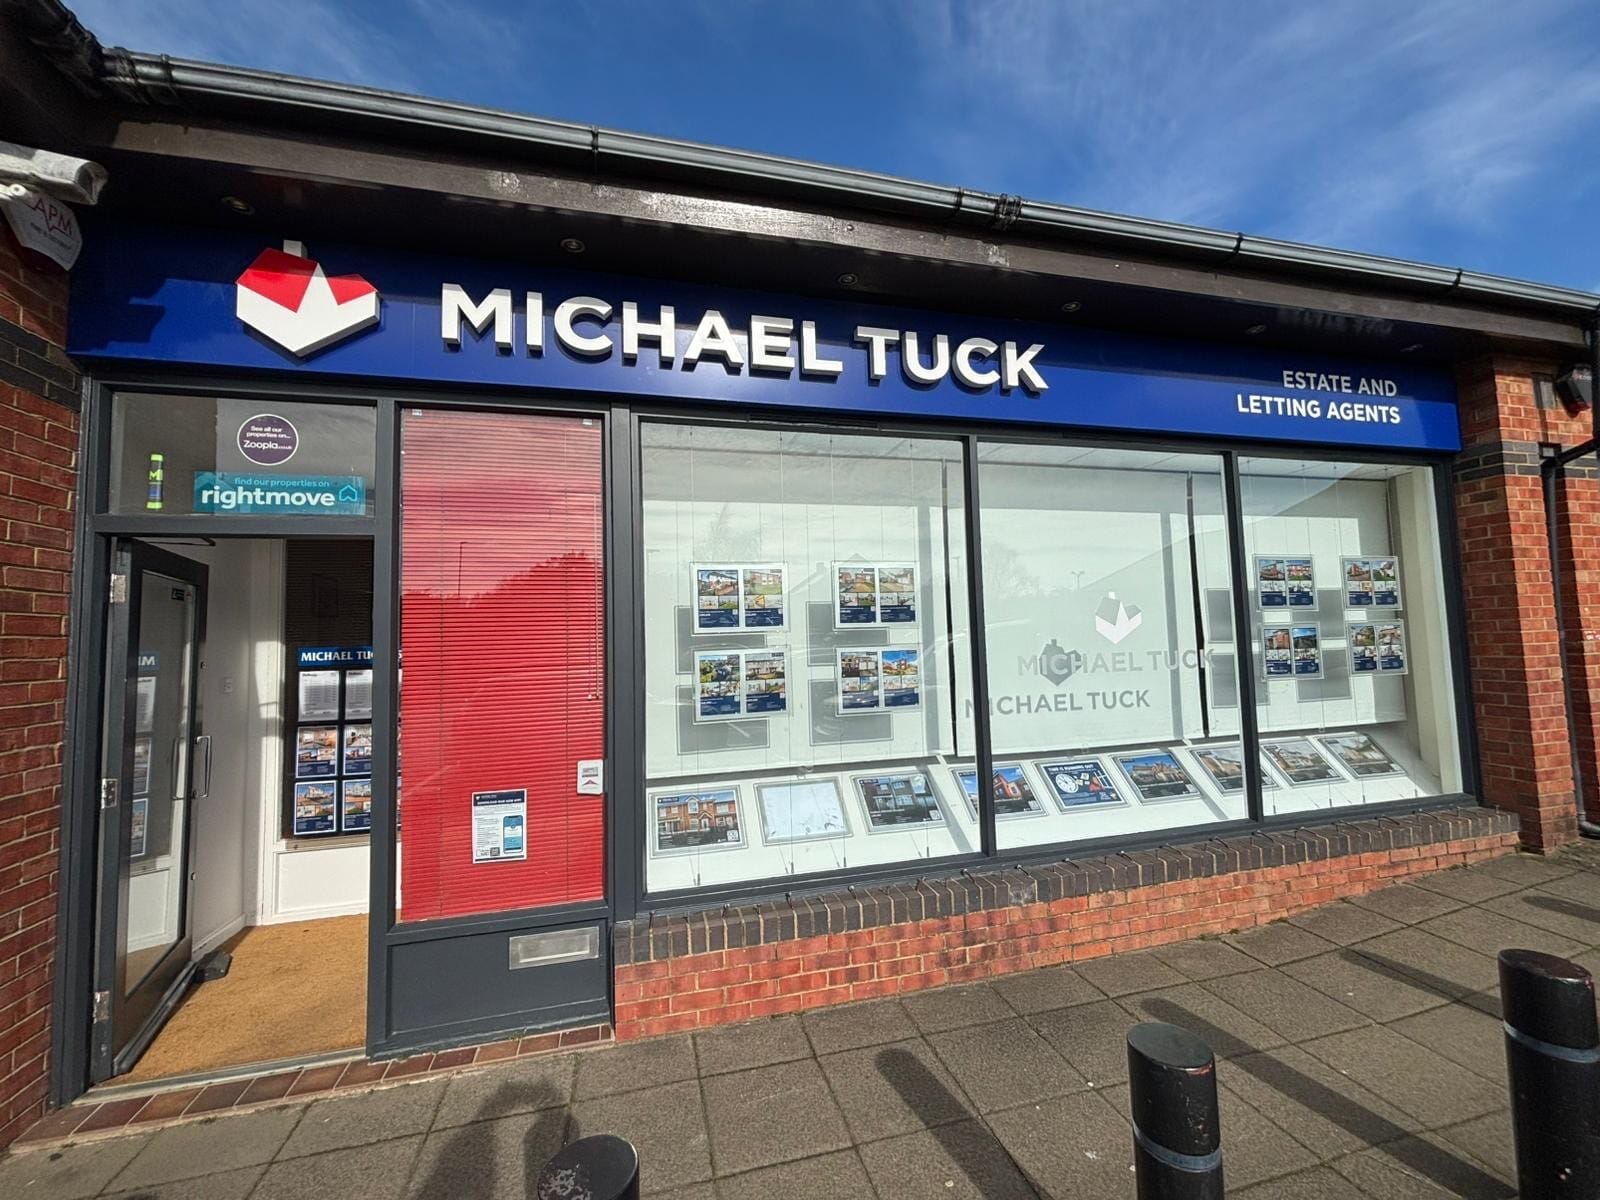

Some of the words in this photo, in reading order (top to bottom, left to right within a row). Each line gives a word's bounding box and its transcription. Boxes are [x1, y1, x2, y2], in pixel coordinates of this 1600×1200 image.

[441, 283, 844, 376] MICHAEL
[854, 325, 1049, 392] TUCK
[1282, 370, 1353, 394] ESTATE
[1357, 378, 1398, 397] AND
[1236, 394, 1321, 418] LETTING
[1326, 402, 1401, 424] AGENTS
[234, 477, 252, 486] find
[253, 478, 270, 487] our
[270, 478, 317, 489] properties
[201, 485, 335, 509] rightmove
[301, 651, 353, 662] MICHAEL
[1017, 651, 1143, 676] MICHAEL
[1147, 648, 1216, 672] TUCK
[1087, 689, 1150, 710] TUCK
